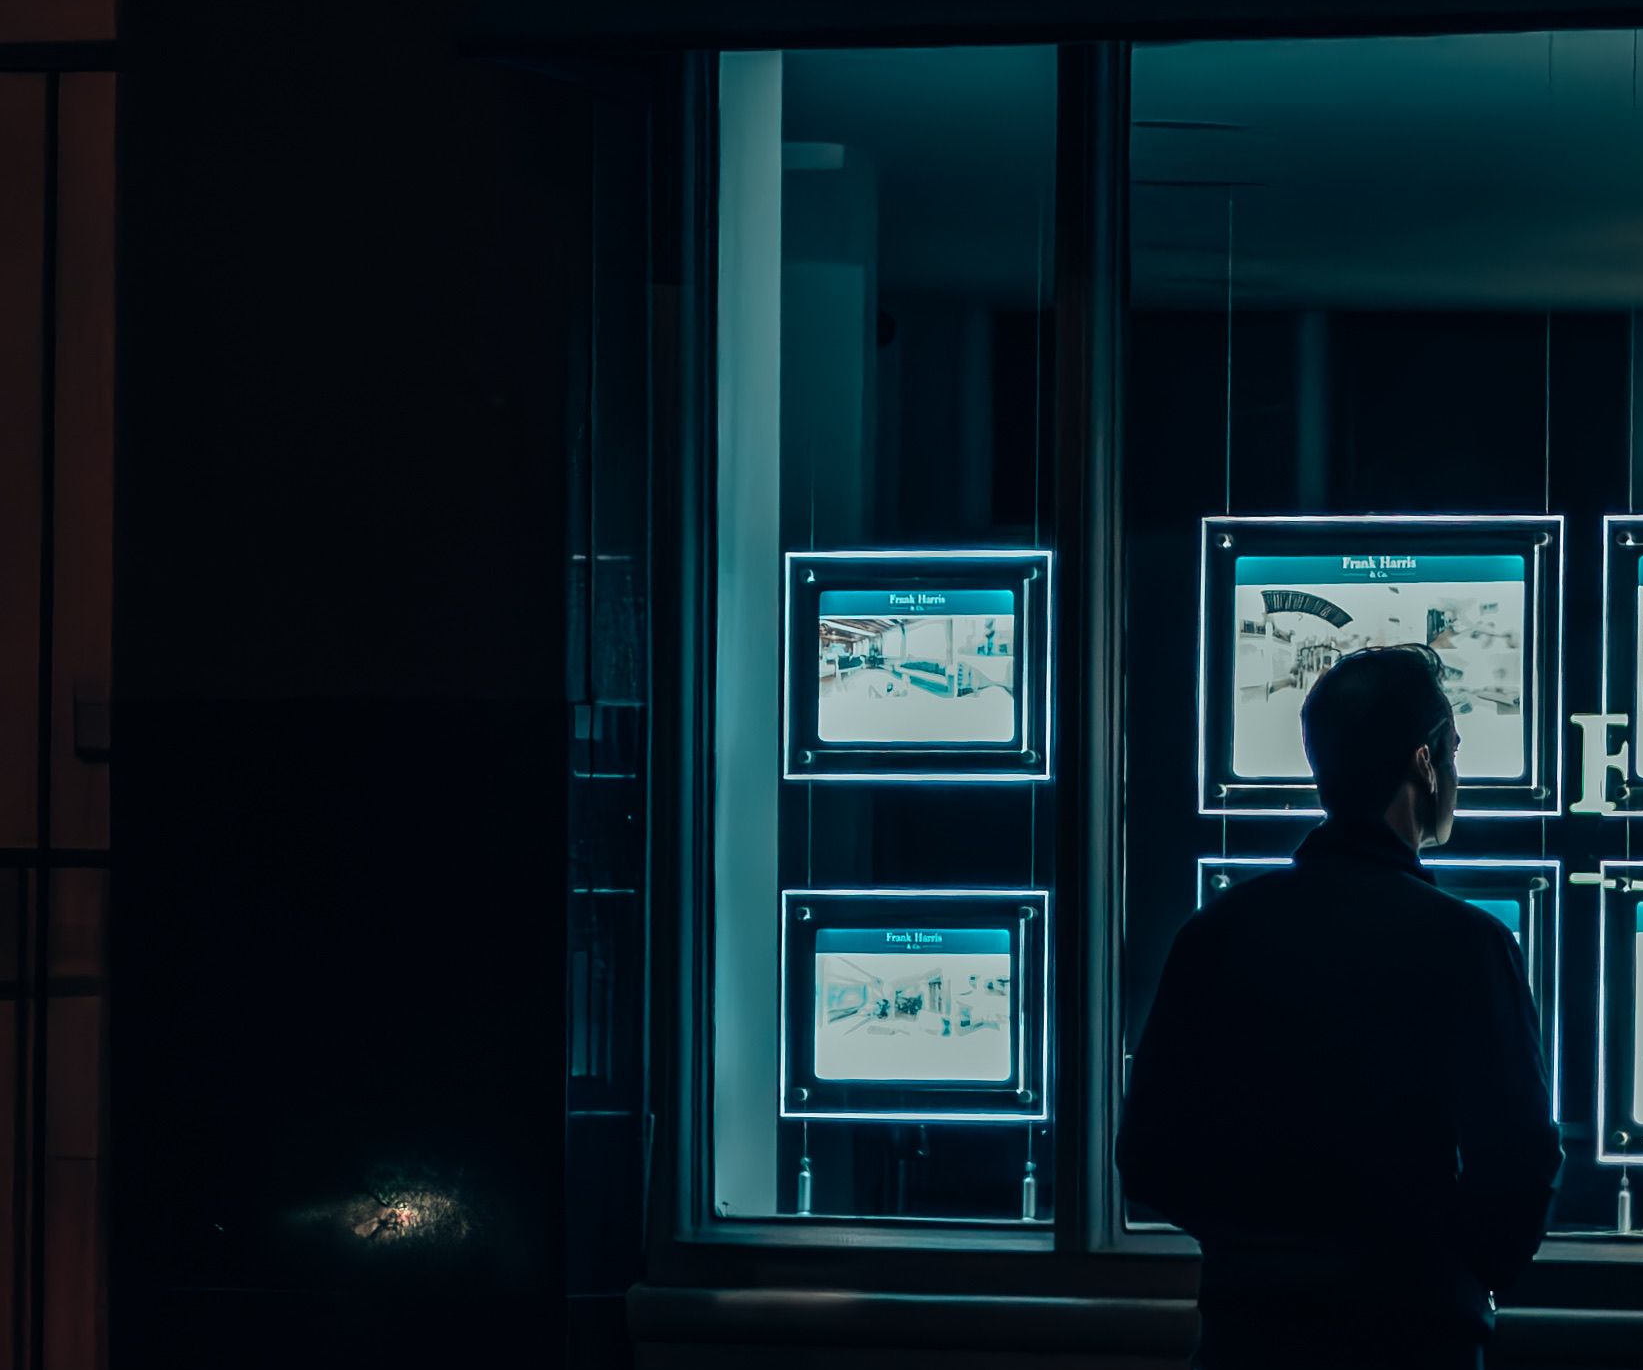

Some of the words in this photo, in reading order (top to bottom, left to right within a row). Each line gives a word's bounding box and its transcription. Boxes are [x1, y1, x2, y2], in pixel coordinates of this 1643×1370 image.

[1342, 555, 1376, 569] Frank
[1380, 555, 1417, 569] Harris
[886, 932, 912, 942] Frank
[914, 932, 943, 943] Harris
